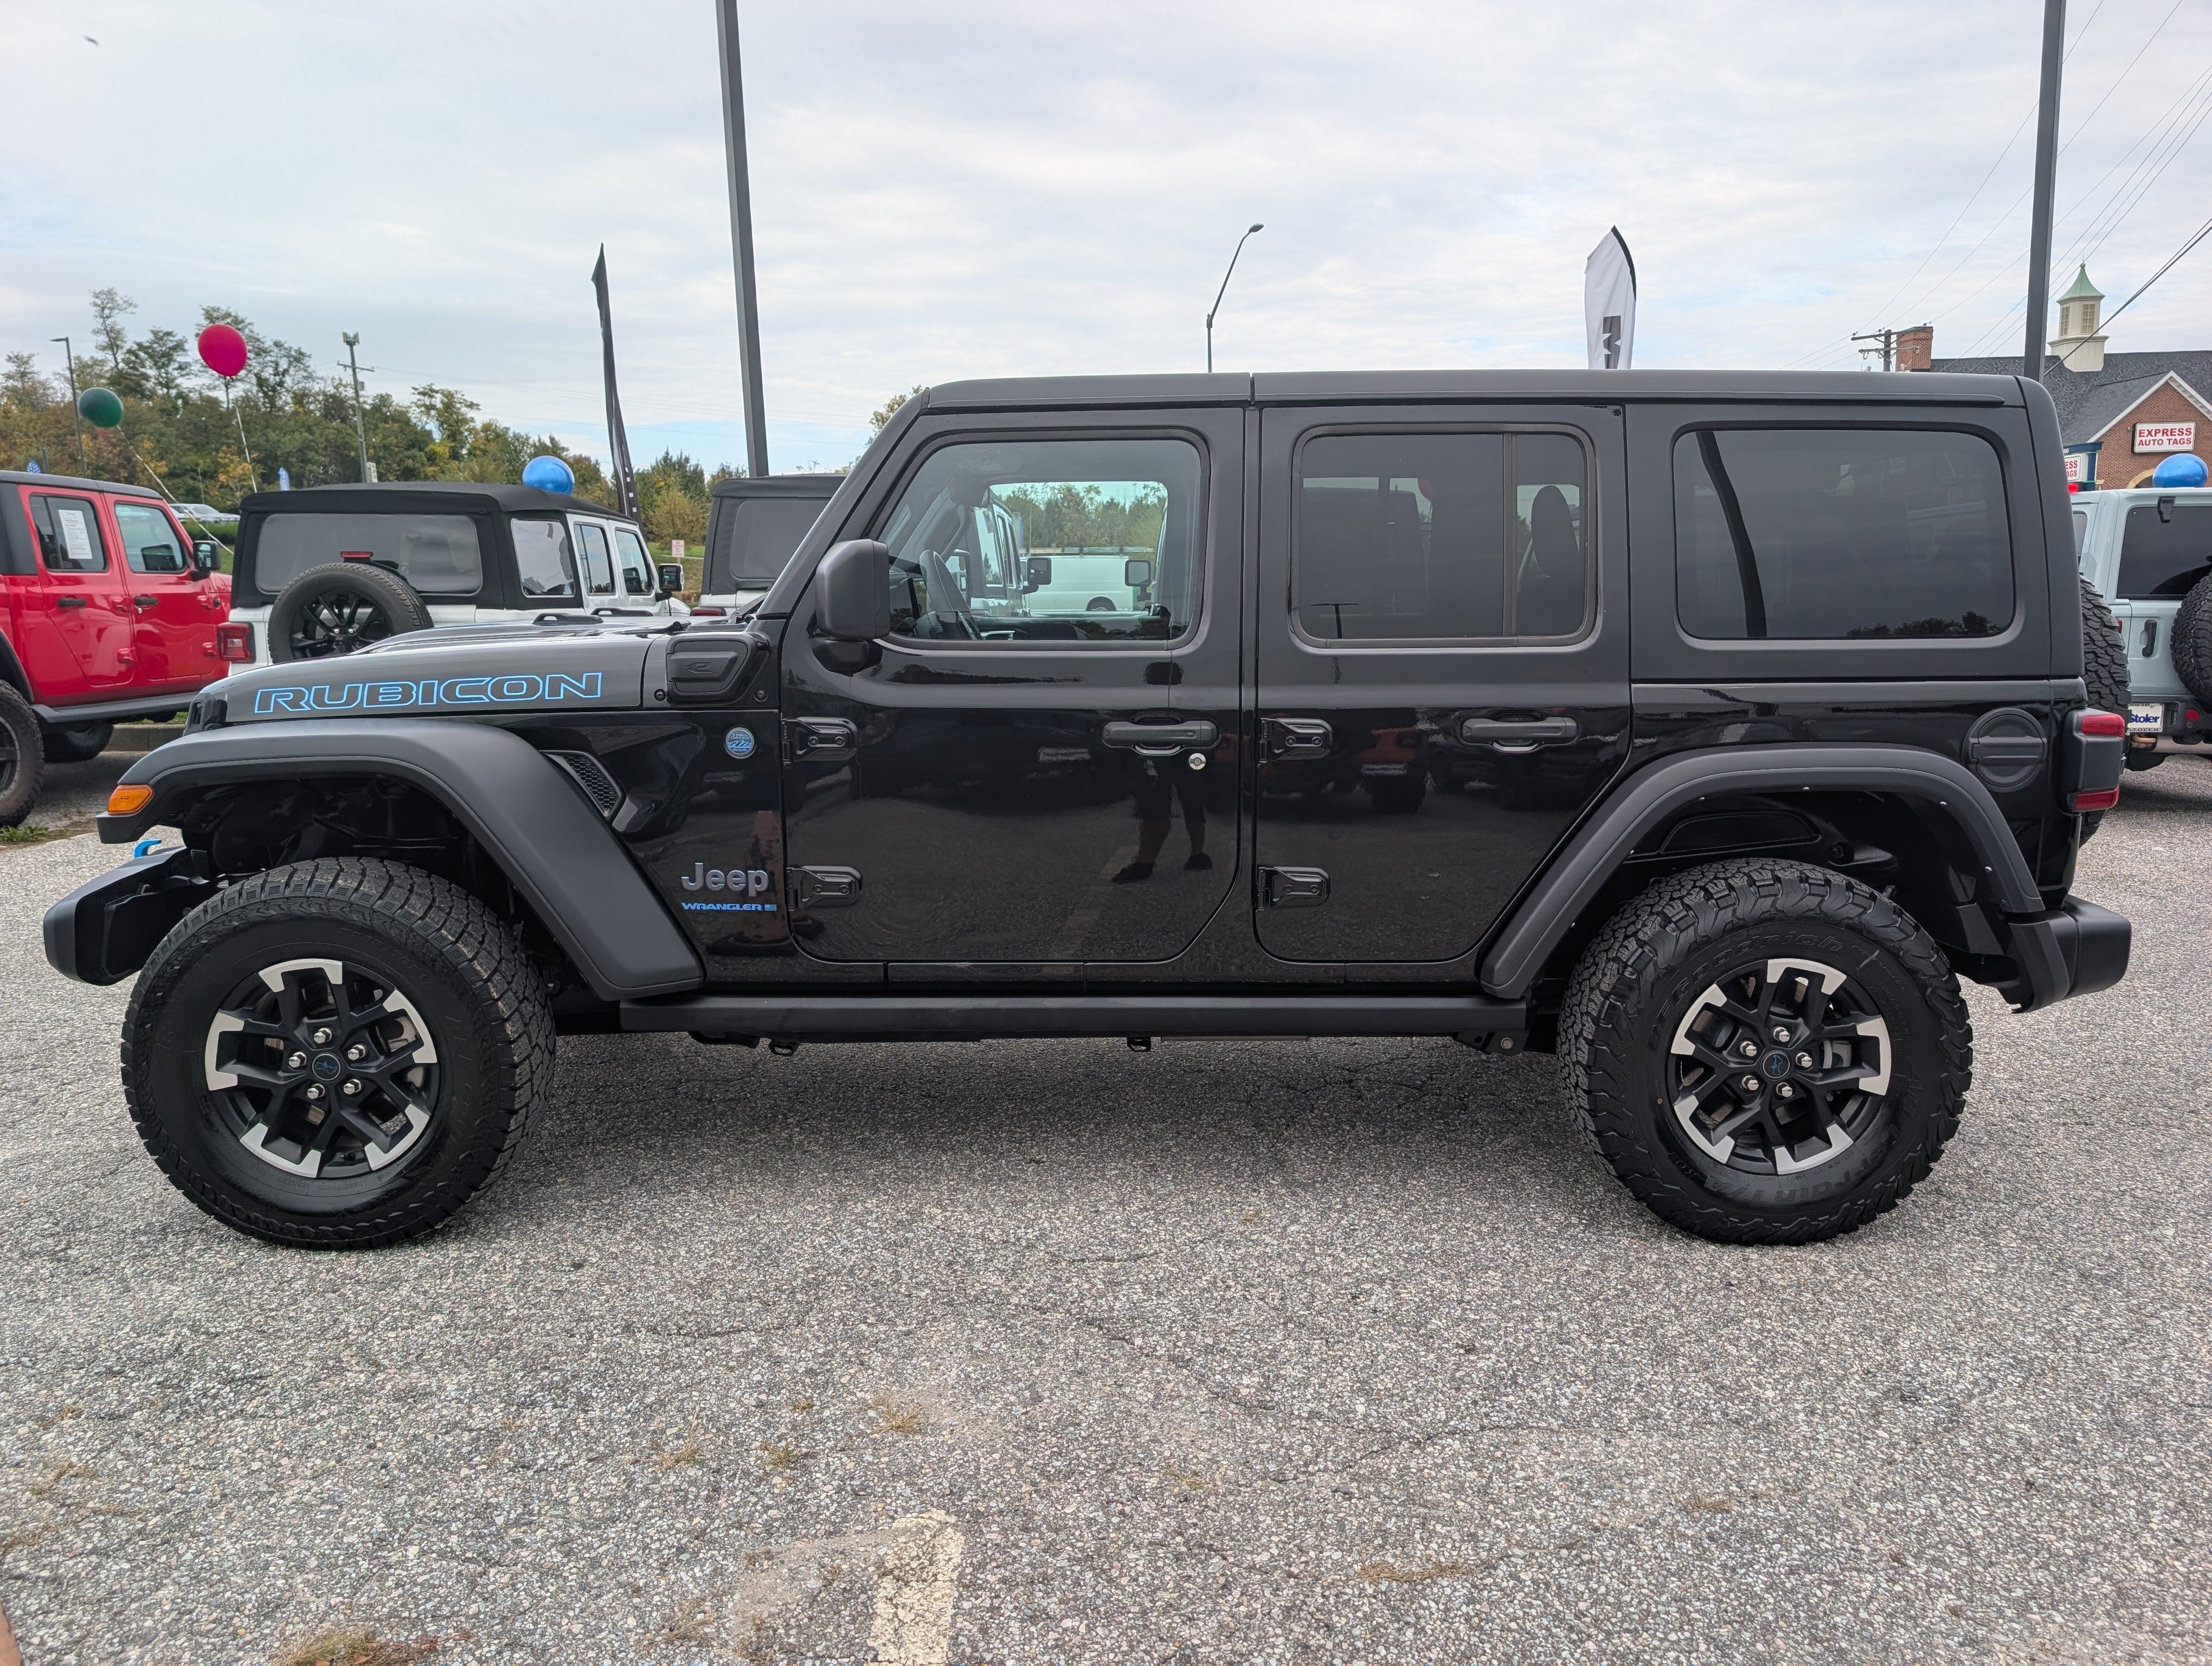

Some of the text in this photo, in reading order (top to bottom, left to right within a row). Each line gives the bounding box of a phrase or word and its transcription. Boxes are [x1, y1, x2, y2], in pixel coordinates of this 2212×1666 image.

[2138, 427, 2192, 438] EXPRESS
[2138, 438, 2164, 446] AUTO
[254, 672, 602, 714] RUBICON
[681, 862, 769, 897] Jeep
[681, 902, 763, 911] WRANGLER
